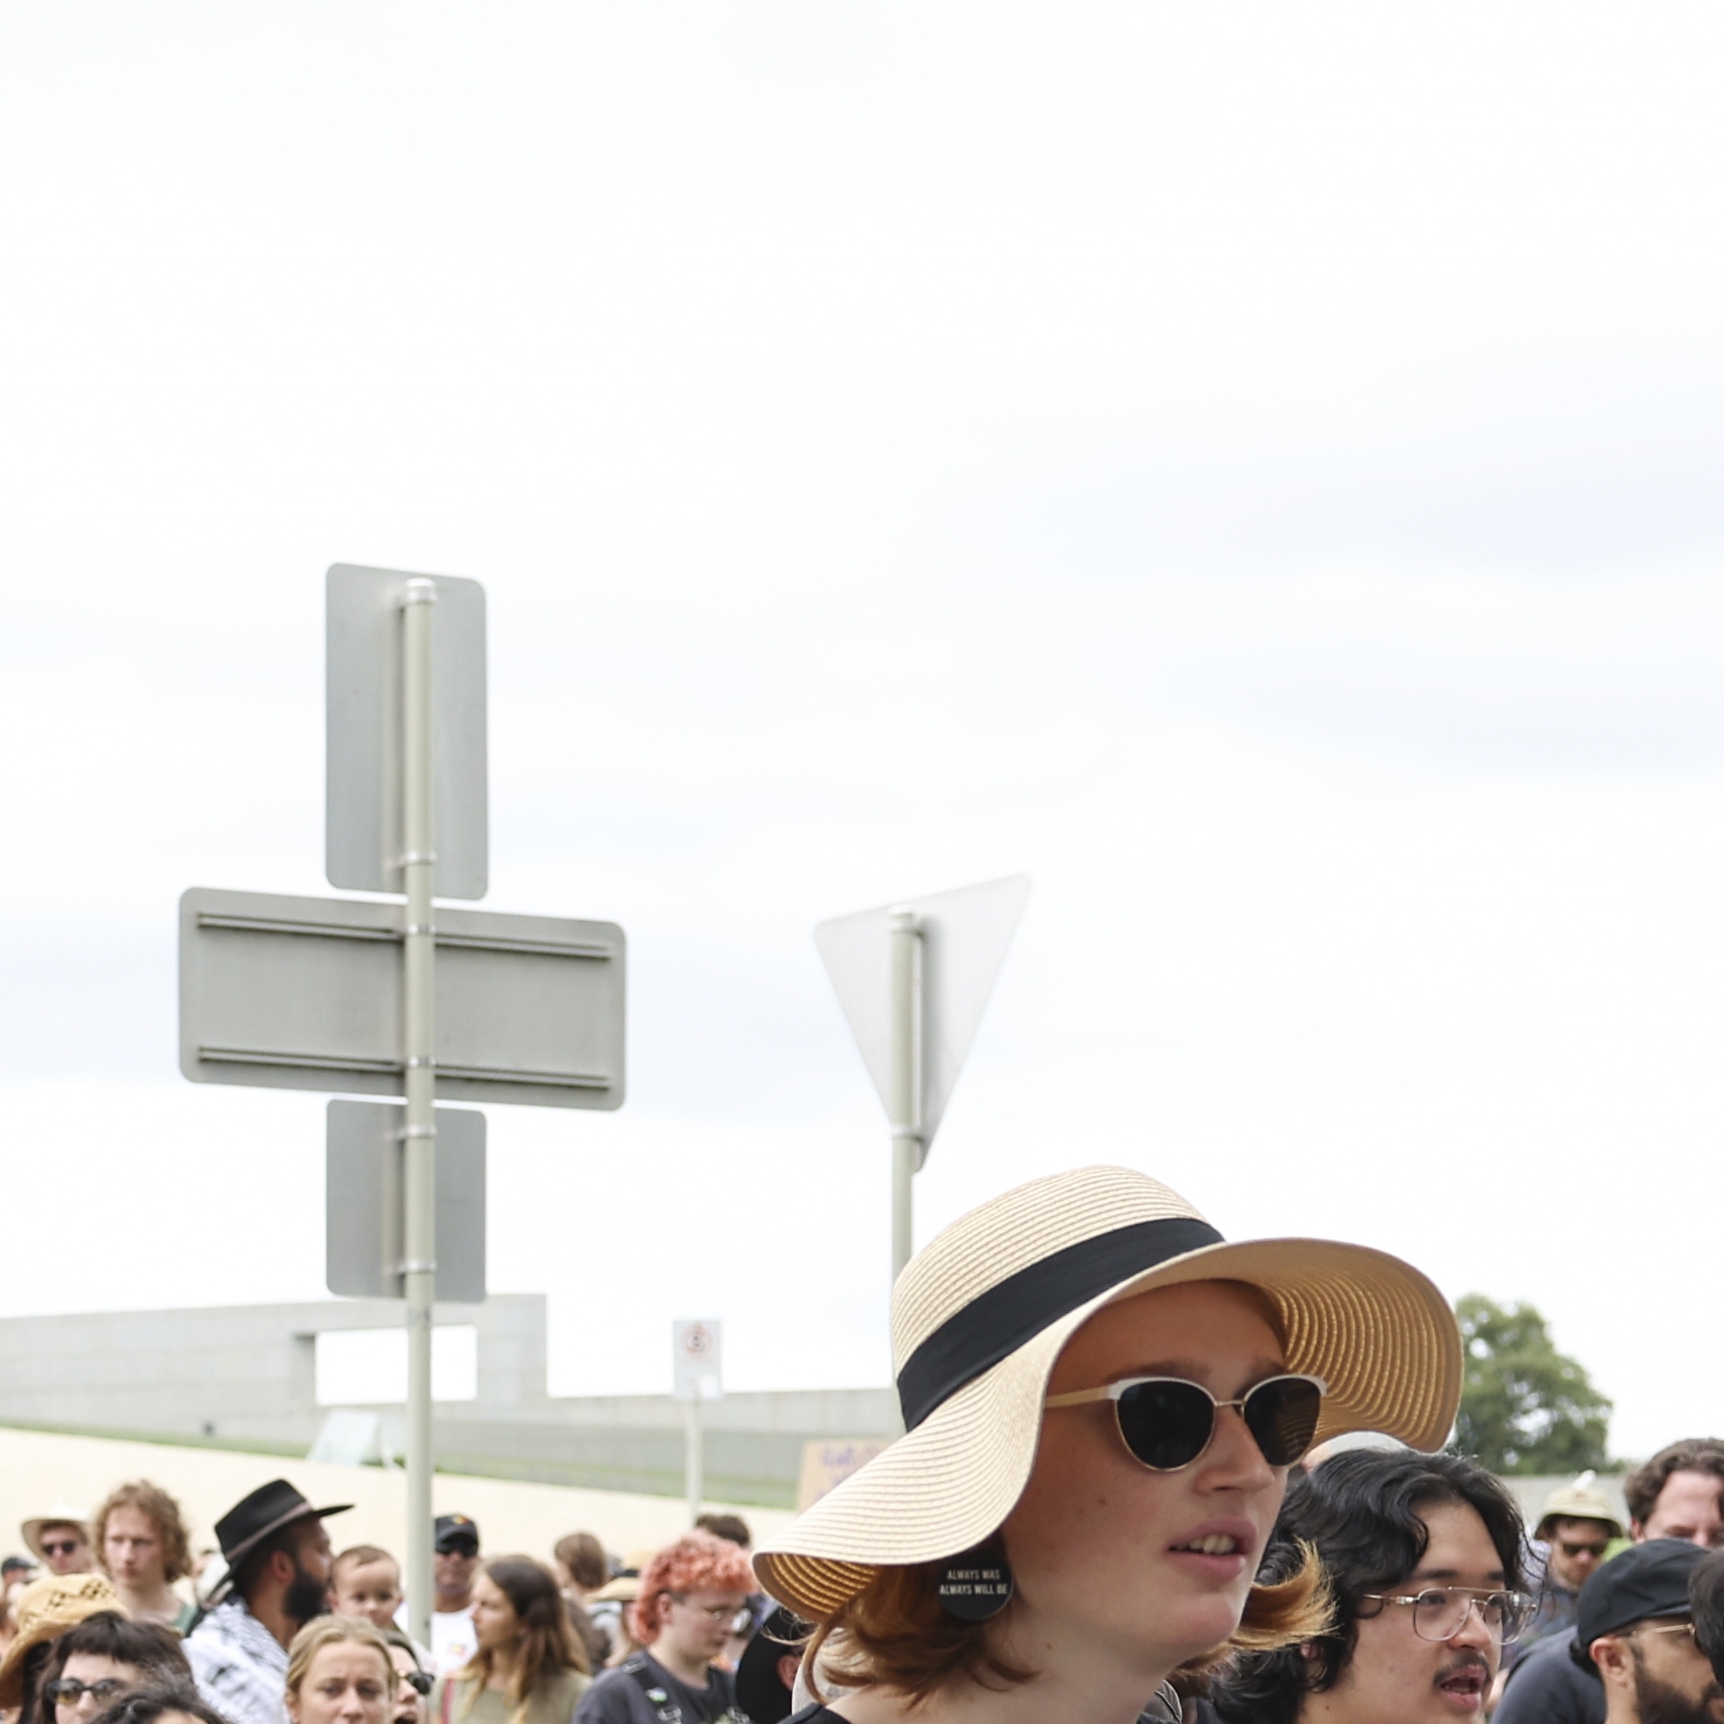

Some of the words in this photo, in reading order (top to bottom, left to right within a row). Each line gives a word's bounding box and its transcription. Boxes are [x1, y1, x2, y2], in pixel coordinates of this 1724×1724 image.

[947, 1569, 980, 1580] ALWAYS
[981, 1569, 1000, 1579] WAS
[939, 1584, 972, 1595] ALWAYS
[974, 1584, 994, 1595] WILL
[996, 1584, 1007, 1594] BE
